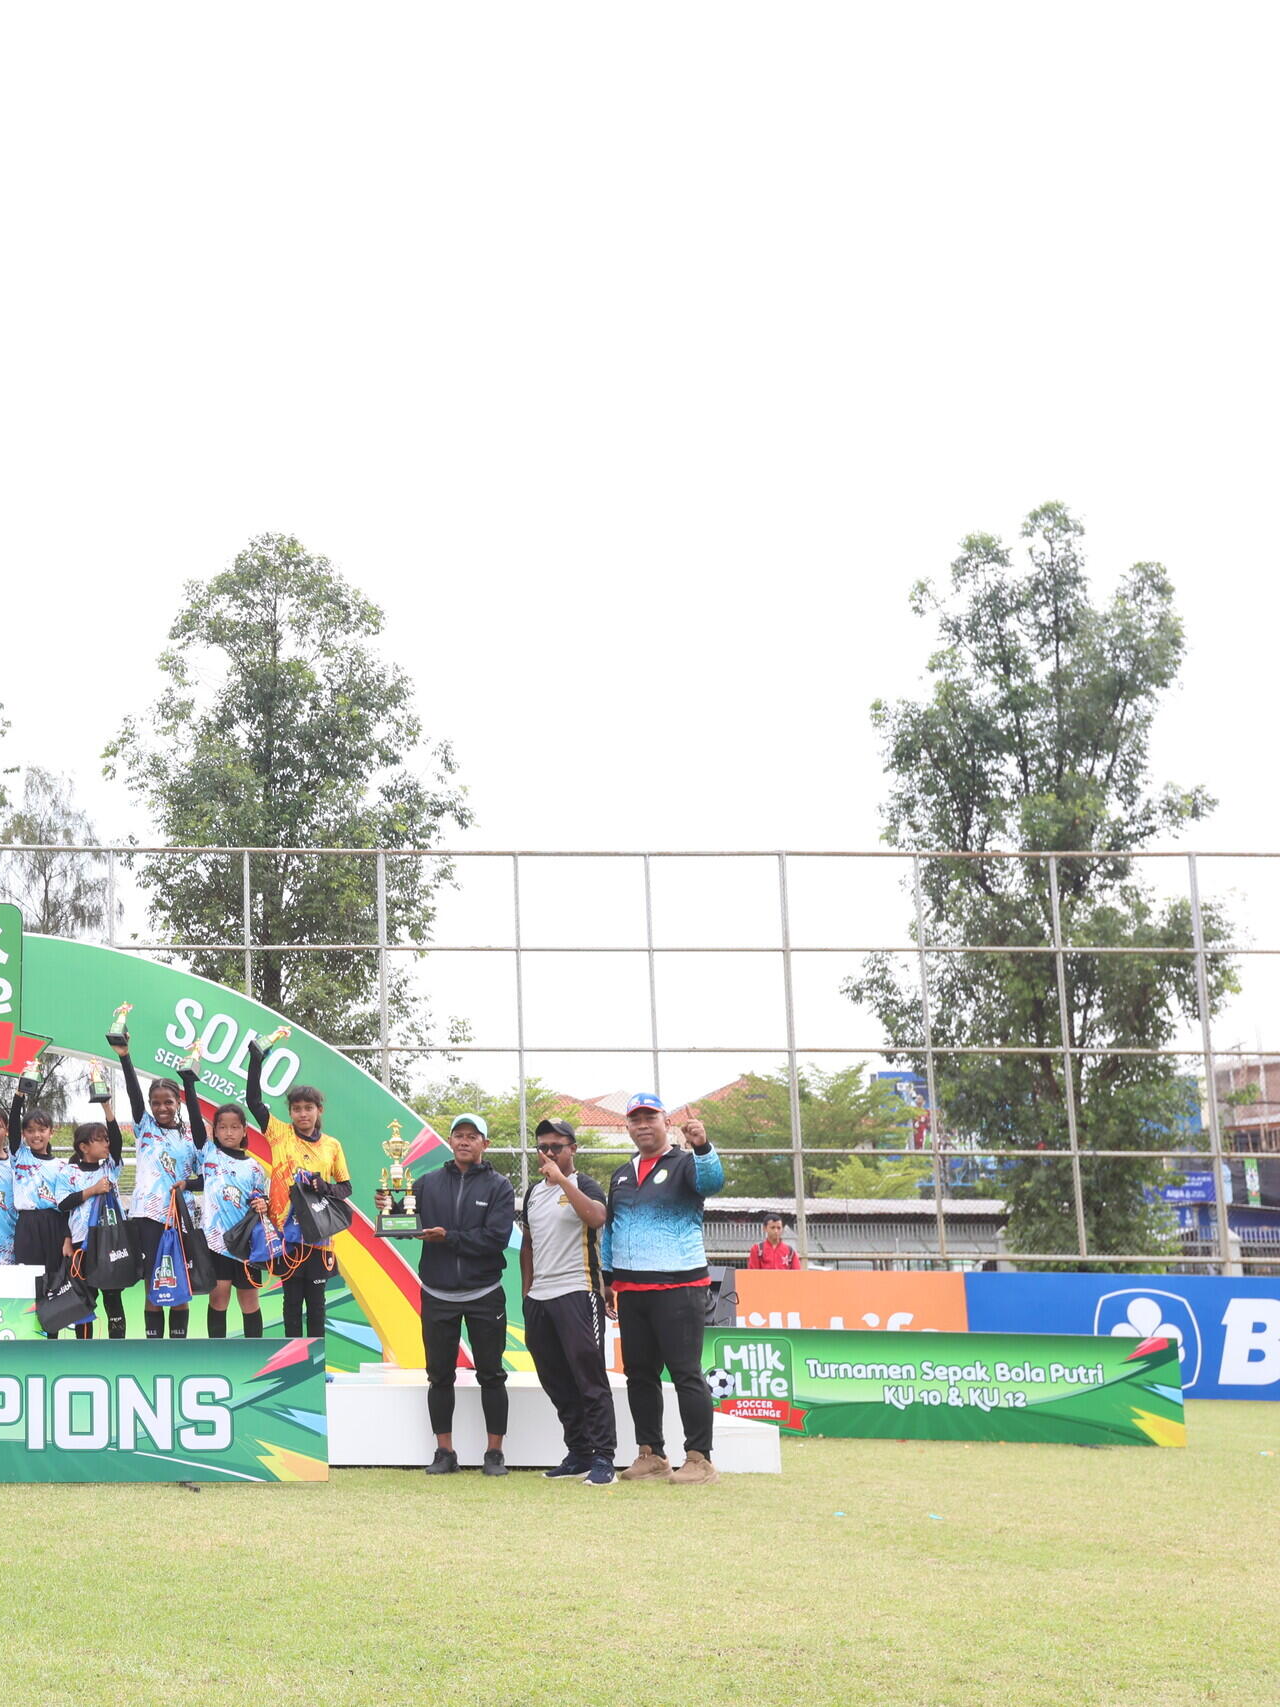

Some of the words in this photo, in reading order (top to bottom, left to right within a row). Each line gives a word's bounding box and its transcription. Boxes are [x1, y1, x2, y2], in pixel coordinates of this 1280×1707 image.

[155, 1048, 182, 1071] SER
[166, 998, 300, 1097] SOLO
[723, 1344, 785, 1372] Milk
[735, 1370, 789, 1398] Life
[805, 1359, 916, 1380] Turnamen
[920, 1361, 991, 1385] Sepak
[995, 1362, 1046, 1383] Bola
[1050, 1363, 1105, 1384] Putri
[736, 1401, 773, 1409] SOCCER
[883, 1386, 914, 1411] KU
[920, 1390, 942, 1406] 10
[947, 1387, 965, 1407] &
[968, 1388, 1001, 1412] KU
[1005, 1392, 1028, 1408] 12
[729, 1409, 782, 1418] CHALLENGE
